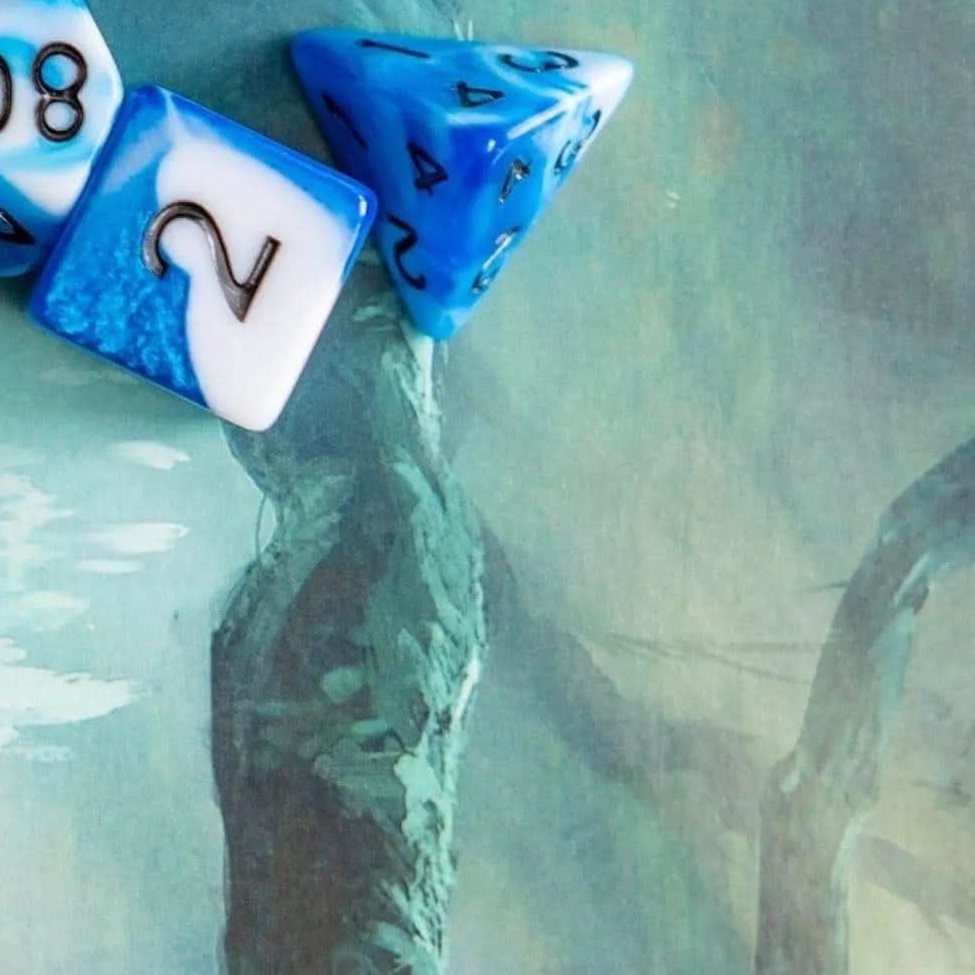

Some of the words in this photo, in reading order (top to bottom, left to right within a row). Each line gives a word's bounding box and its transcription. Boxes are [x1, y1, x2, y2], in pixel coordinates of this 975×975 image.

[407, 141, 450, 198] 4
[140, 200, 282, 324] 2
[387, 213, 428, 292] 2
